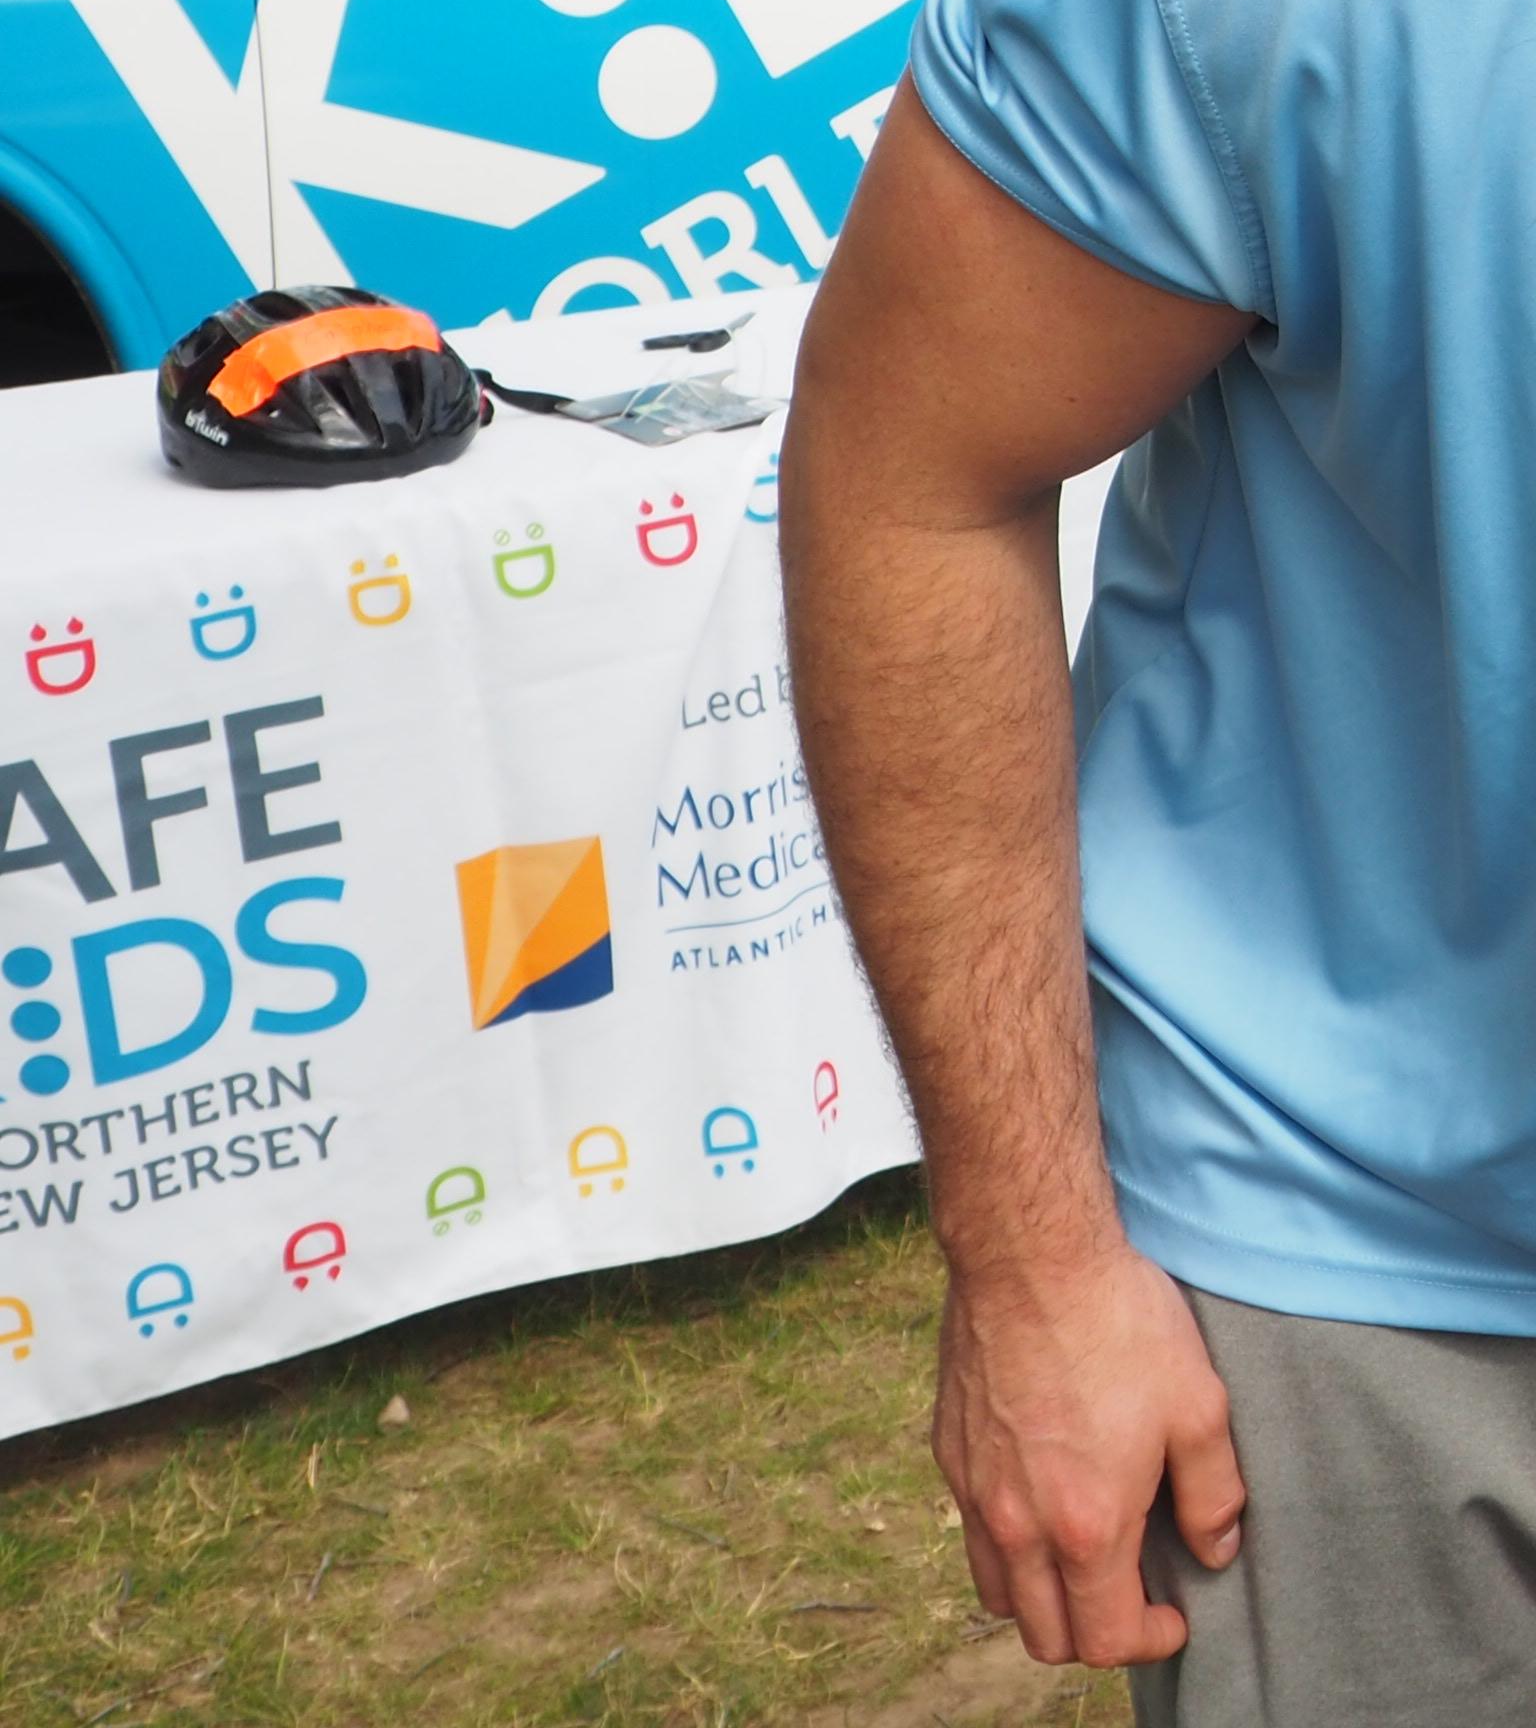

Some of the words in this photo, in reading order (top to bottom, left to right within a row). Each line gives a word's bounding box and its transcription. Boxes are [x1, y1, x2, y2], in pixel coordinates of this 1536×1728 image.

[682, 674, 767, 729] Led
[671, 917, 804, 972] ATLANTIC
[109, 1115, 338, 1213] JERSEY
